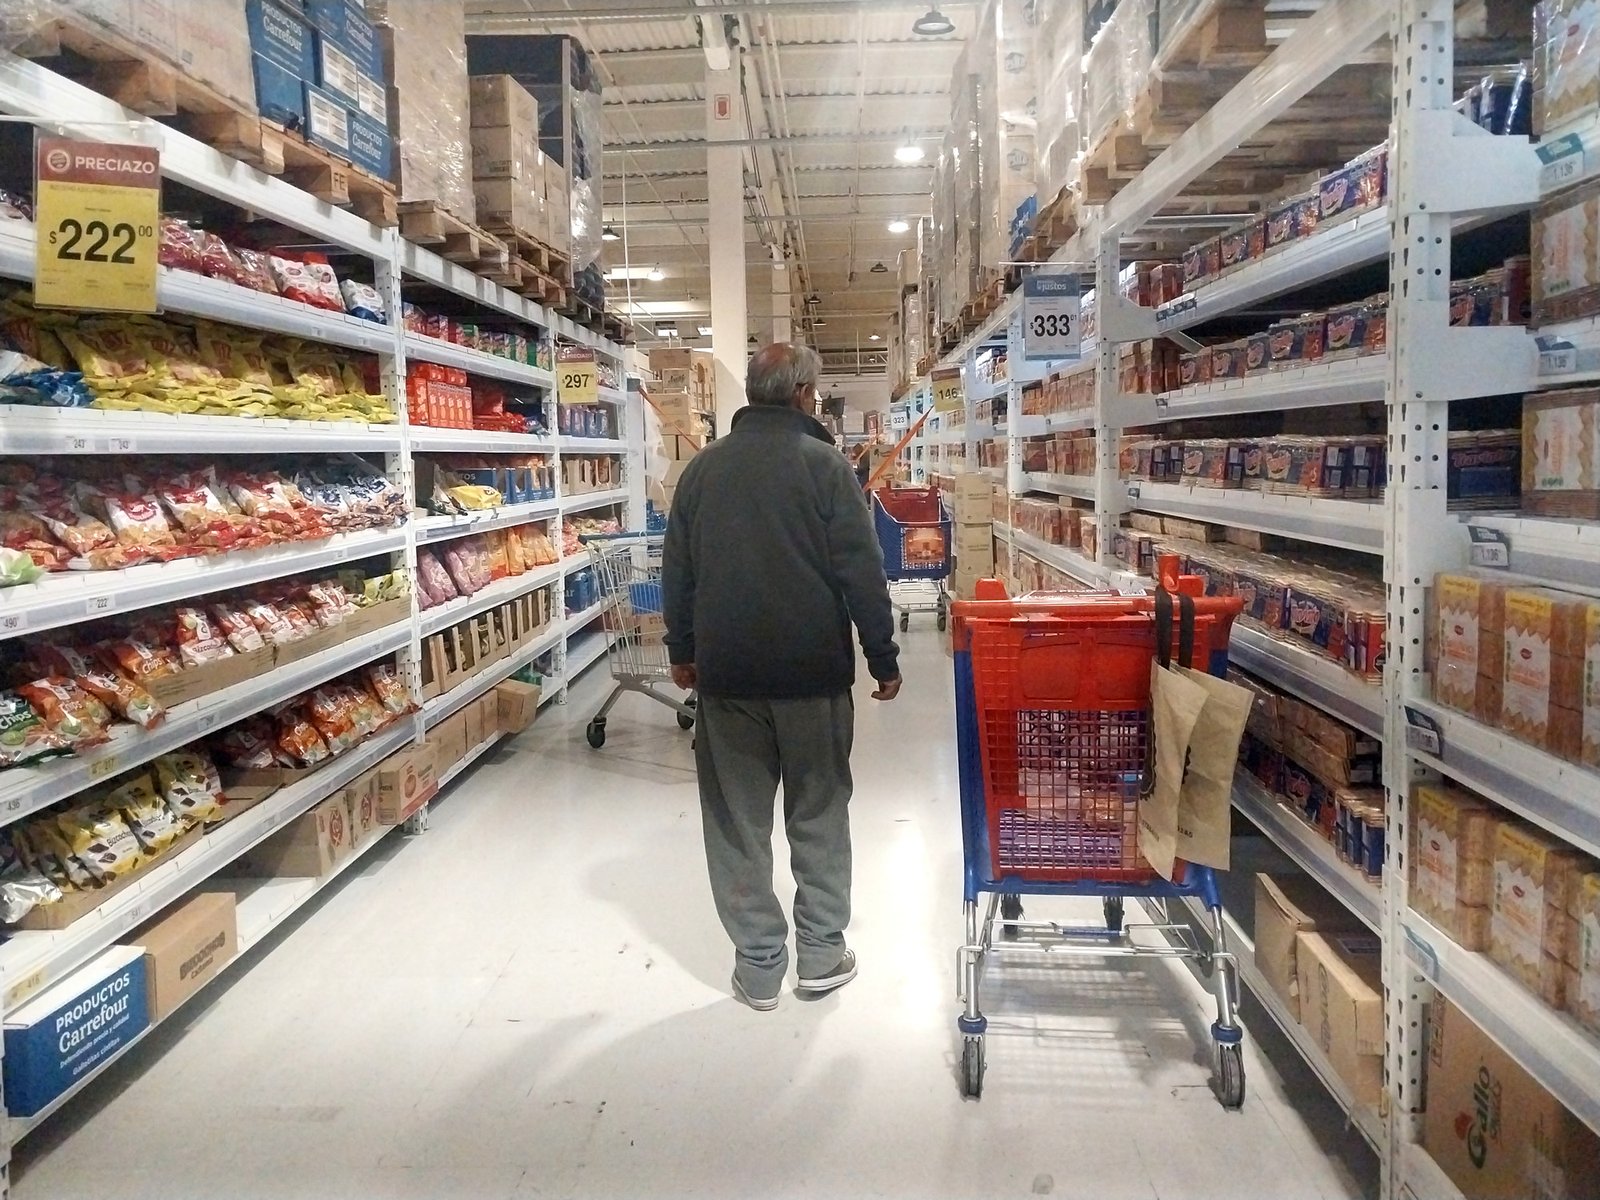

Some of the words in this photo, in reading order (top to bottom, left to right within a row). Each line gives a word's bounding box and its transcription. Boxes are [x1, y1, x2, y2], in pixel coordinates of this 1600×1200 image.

[261, 1, 303, 36] PRODUCTOS
[263, 16, 303, 52] Carrefour
[352, 121, 383, 147] PRODUCTOS
[352, 134, 382, 160] Carrefour
[75, 155, 156, 175] PRECIAZO
[938, 387, 958, 401] 146
[0, 710, 32, 730] Chips
[56, 972, 131, 1034] PRODUCTOS
[59, 993, 130, 1053] Carrefour
[1467, 1065, 1490, 1170] Gallo
